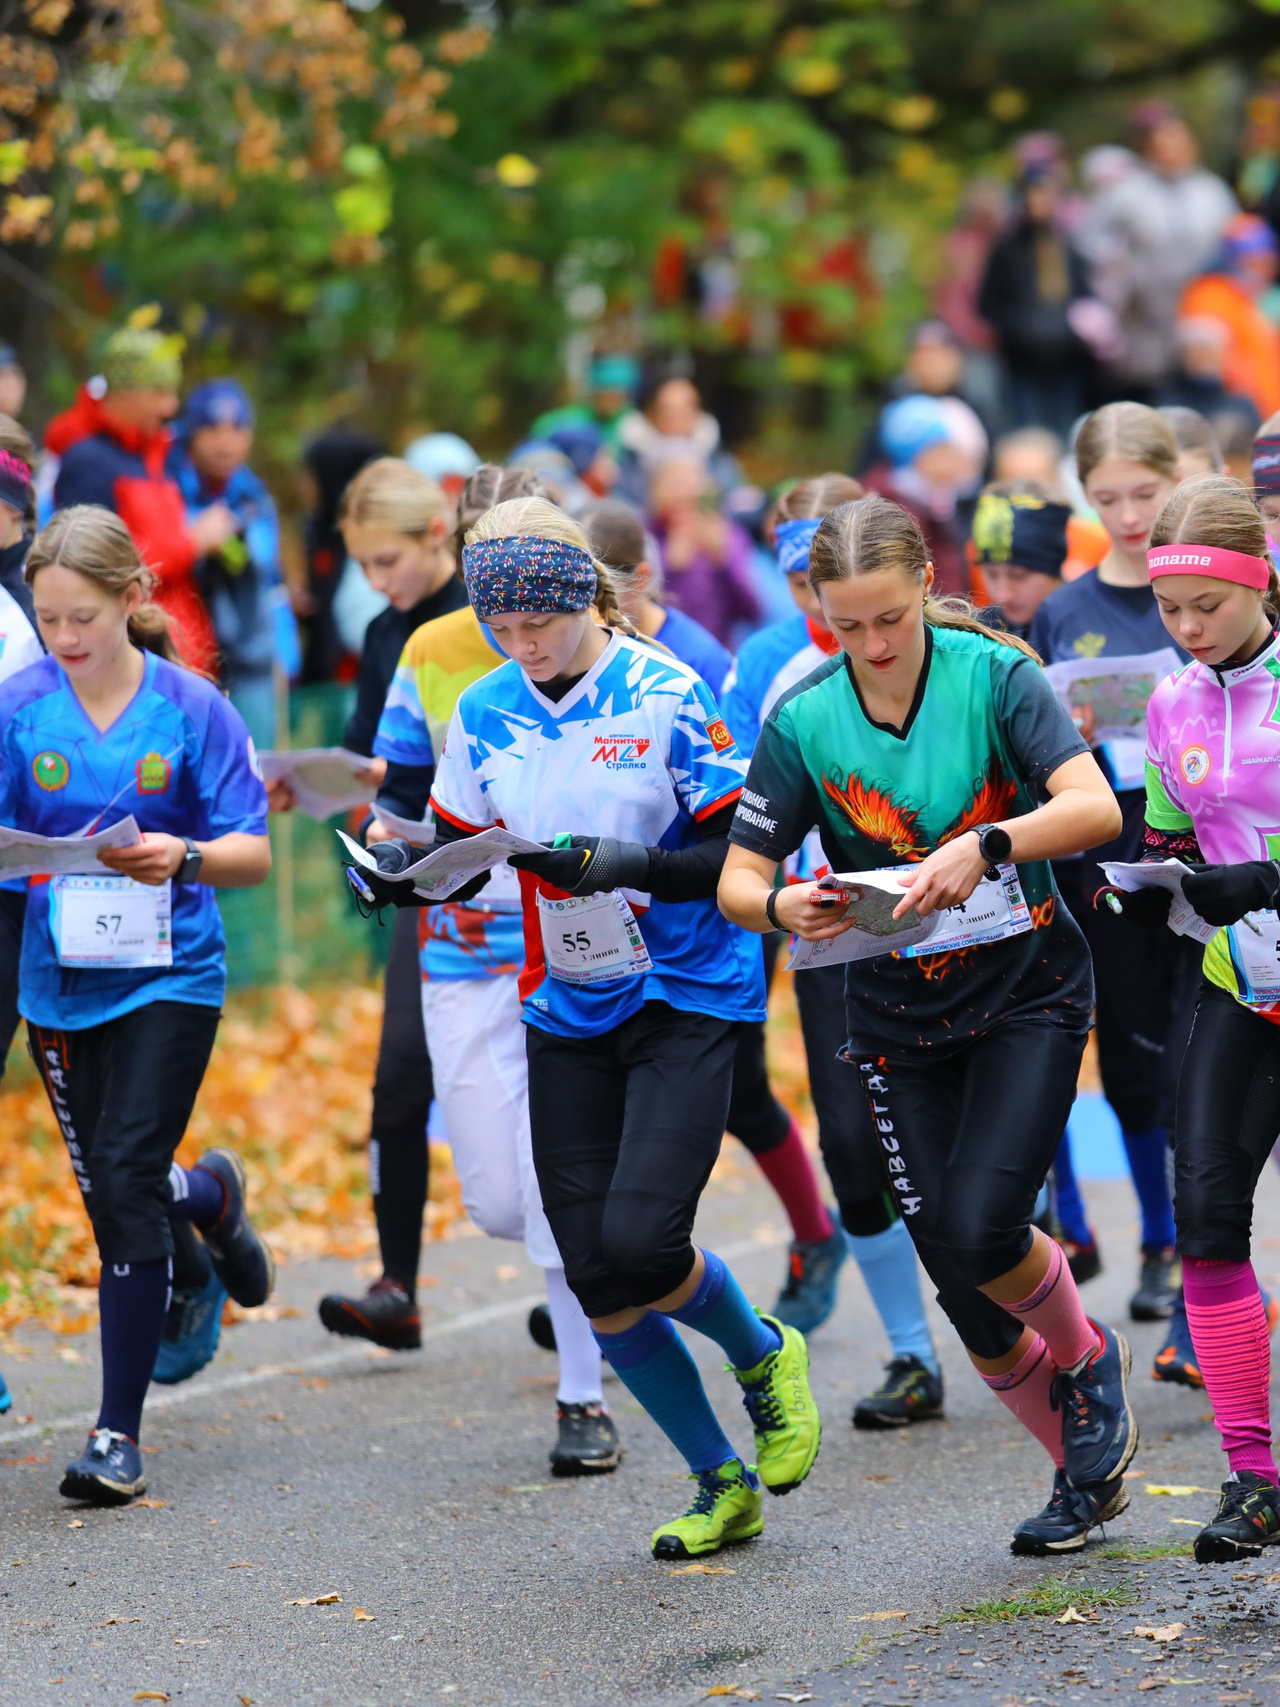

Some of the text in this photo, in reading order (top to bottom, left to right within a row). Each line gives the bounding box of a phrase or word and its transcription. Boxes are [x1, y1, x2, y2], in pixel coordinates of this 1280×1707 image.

[1148, 553, 1212, 569] noname
[593, 736, 650, 745] Магнитная
[605, 760, 647, 771] Стрелка
[1002, 873, 1017, 882] evo
[95, 914, 122, 935] 57
[957, 910, 996, 926] 3 линия
[562, 930, 592, 953] 55
[961, 932, 1006, 948] СОРЕВНОВАНИЯ
[581, 954, 588, 962] 3
[589, 948, 620, 961] линия
[582, 969, 625, 983] СОРЕВНОВАНИЯ
